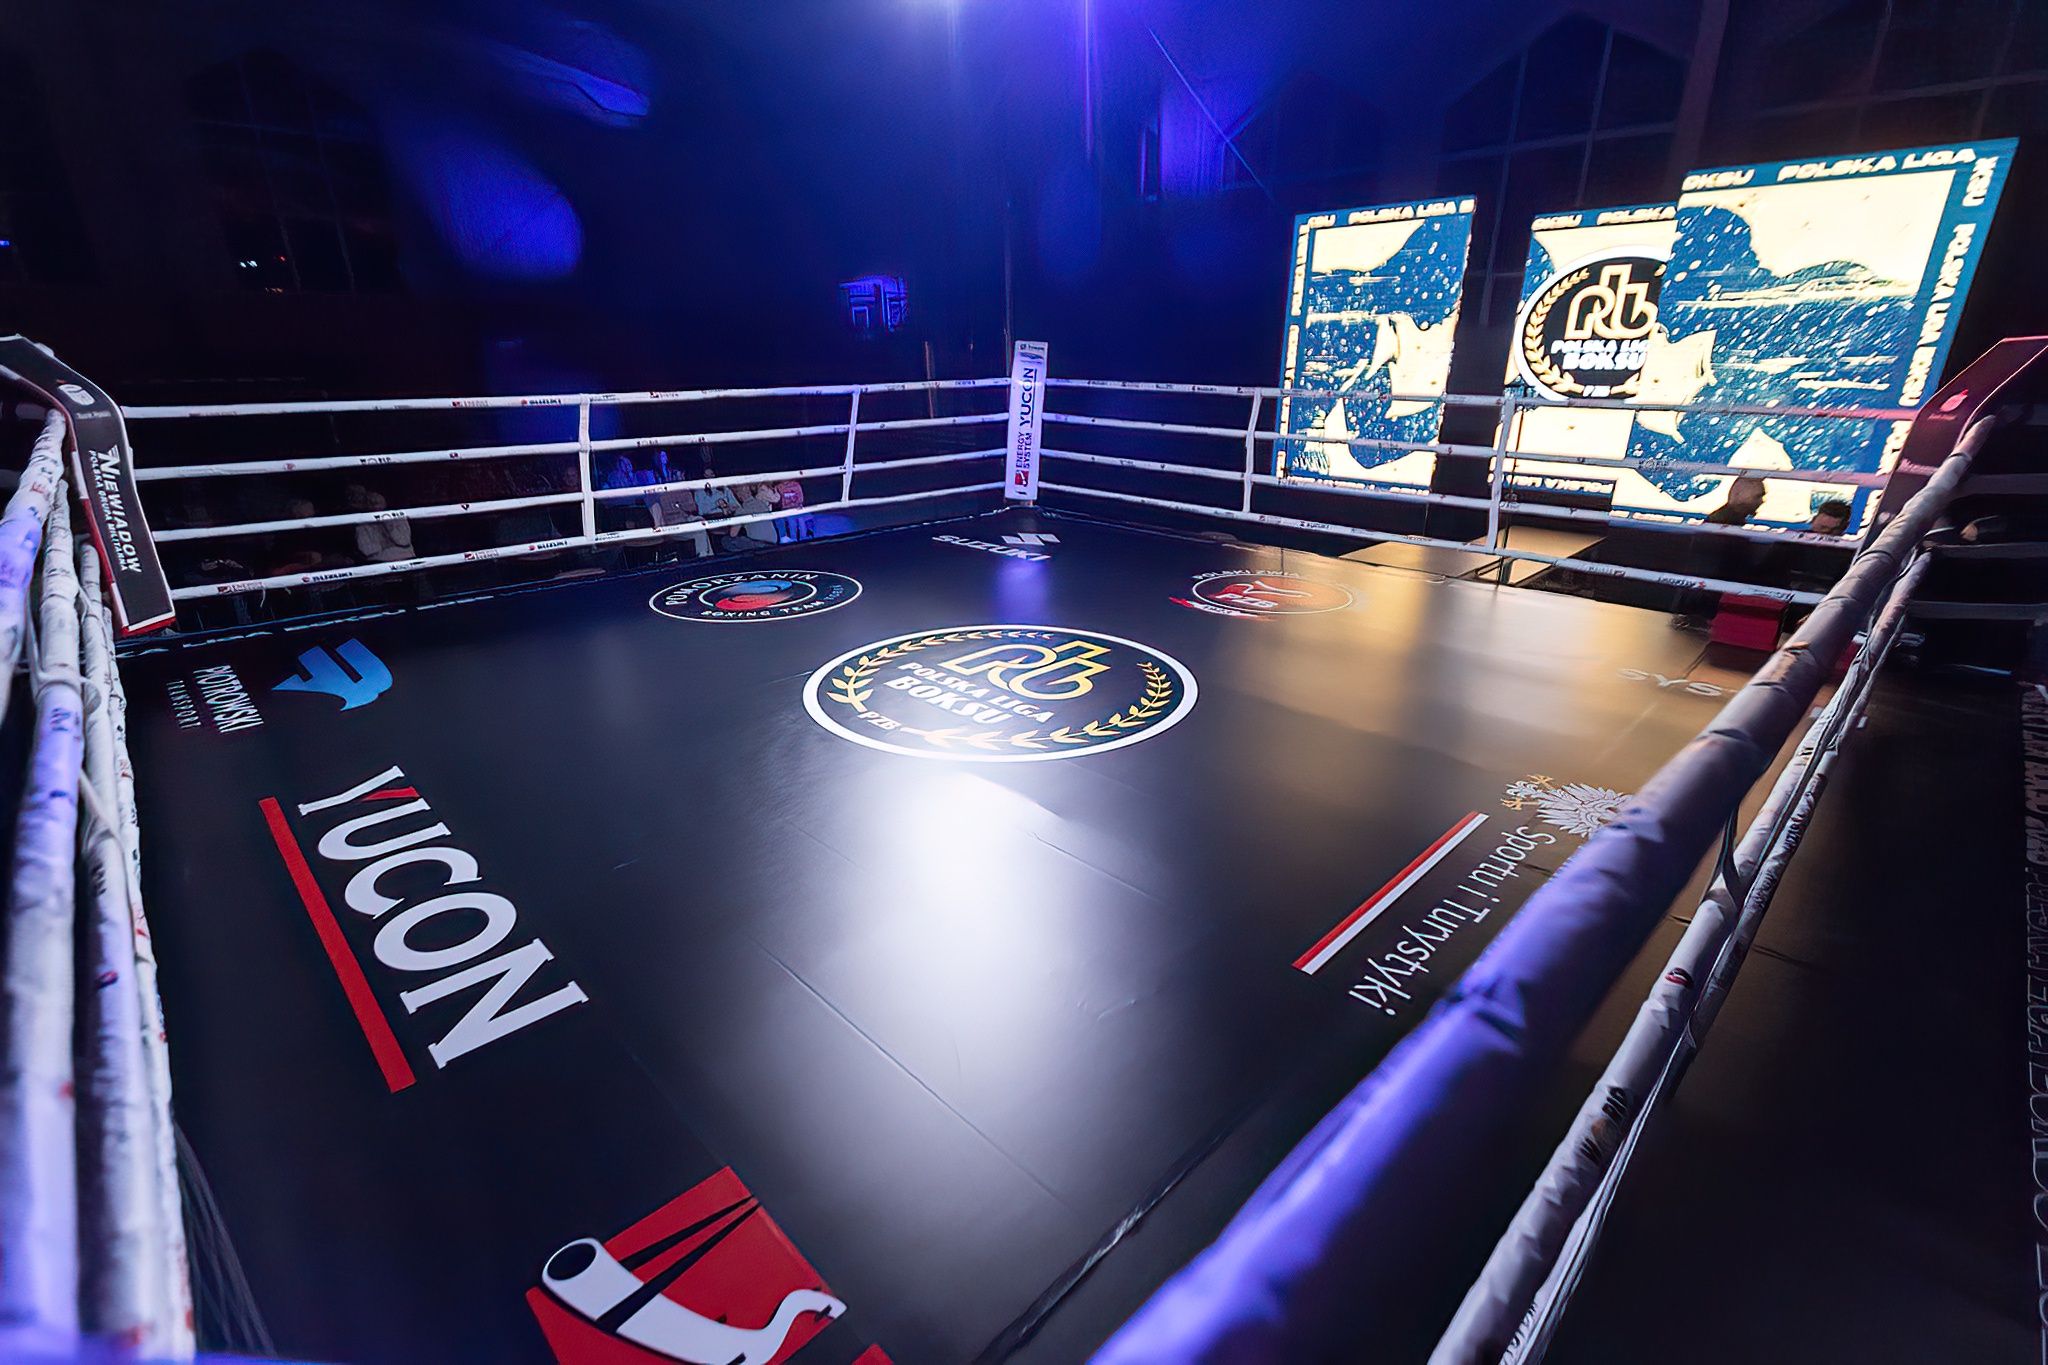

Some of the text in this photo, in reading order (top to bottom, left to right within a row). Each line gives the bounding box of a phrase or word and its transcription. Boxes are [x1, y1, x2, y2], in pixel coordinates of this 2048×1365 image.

[1777, 155, 1896, 182] POLSKA
[1902, 148, 1977, 170] LIGA
[1931, 223, 1976, 302] POLSKA
[1562, 353, 1642, 371] BOKSU
[1020, 367, 1035, 427] YUCON
[1016, 432, 1025, 468] ENERGY
[1023, 432, 1032, 469] SYSTEM
[932, 534, 1051, 562] SUZUKI
[665, 573, 818, 606] POMORZANIN
[700, 610, 771, 618] BOXING
[779, 600, 825, 614] TEAM
[193, 665, 264, 733] PIOTROWSKI
[883, 675, 1013, 725] BOKSU
[897, 662, 1055, 723] POLSKA LIGA
[1616, 668, 1738, 697] SYS
[857, 711, 902, 731] PZB
[298, 765, 589, 1070] YUCON
[1349, 826, 1557, 1016] Sportu i Turystyki
